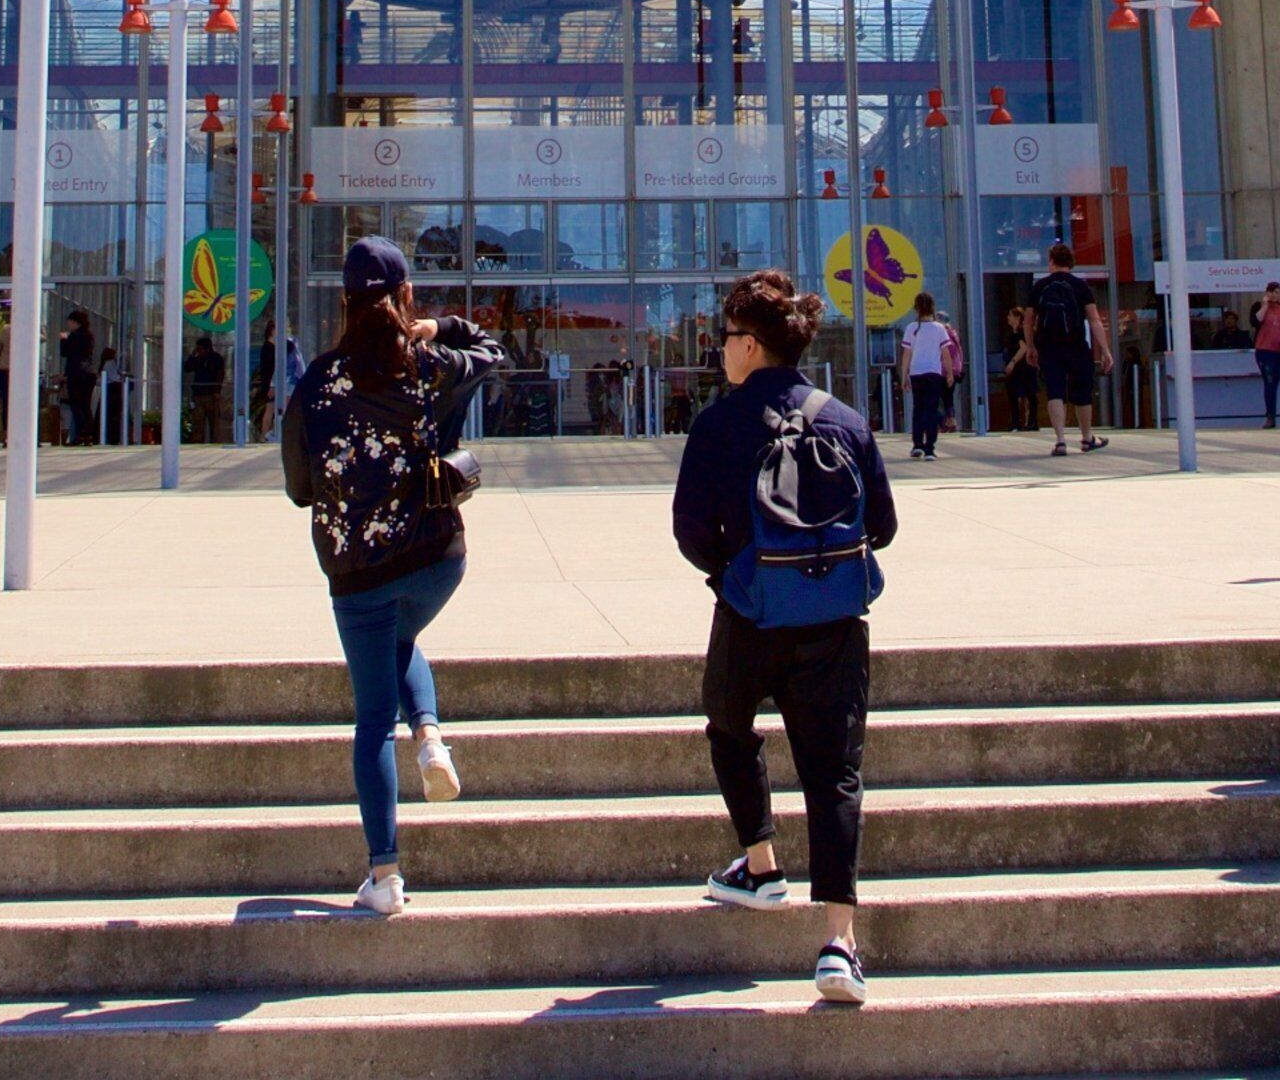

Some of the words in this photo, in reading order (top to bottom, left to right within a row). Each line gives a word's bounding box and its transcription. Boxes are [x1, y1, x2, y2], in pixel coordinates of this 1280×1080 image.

[339, 174, 397, 189] Ticketed
[400, 174, 437, 190] Entry
[517, 173, 582, 187] Members
[643, 172, 725, 186] Pre-ticketed
[728, 172, 778, 188] Groups
[1015, 170, 1040, 184] Exit
[72, 177, 109, 193] Entry
[1207, 266, 1240, 277] Service
[1241, 265, 1264, 275] Desk
